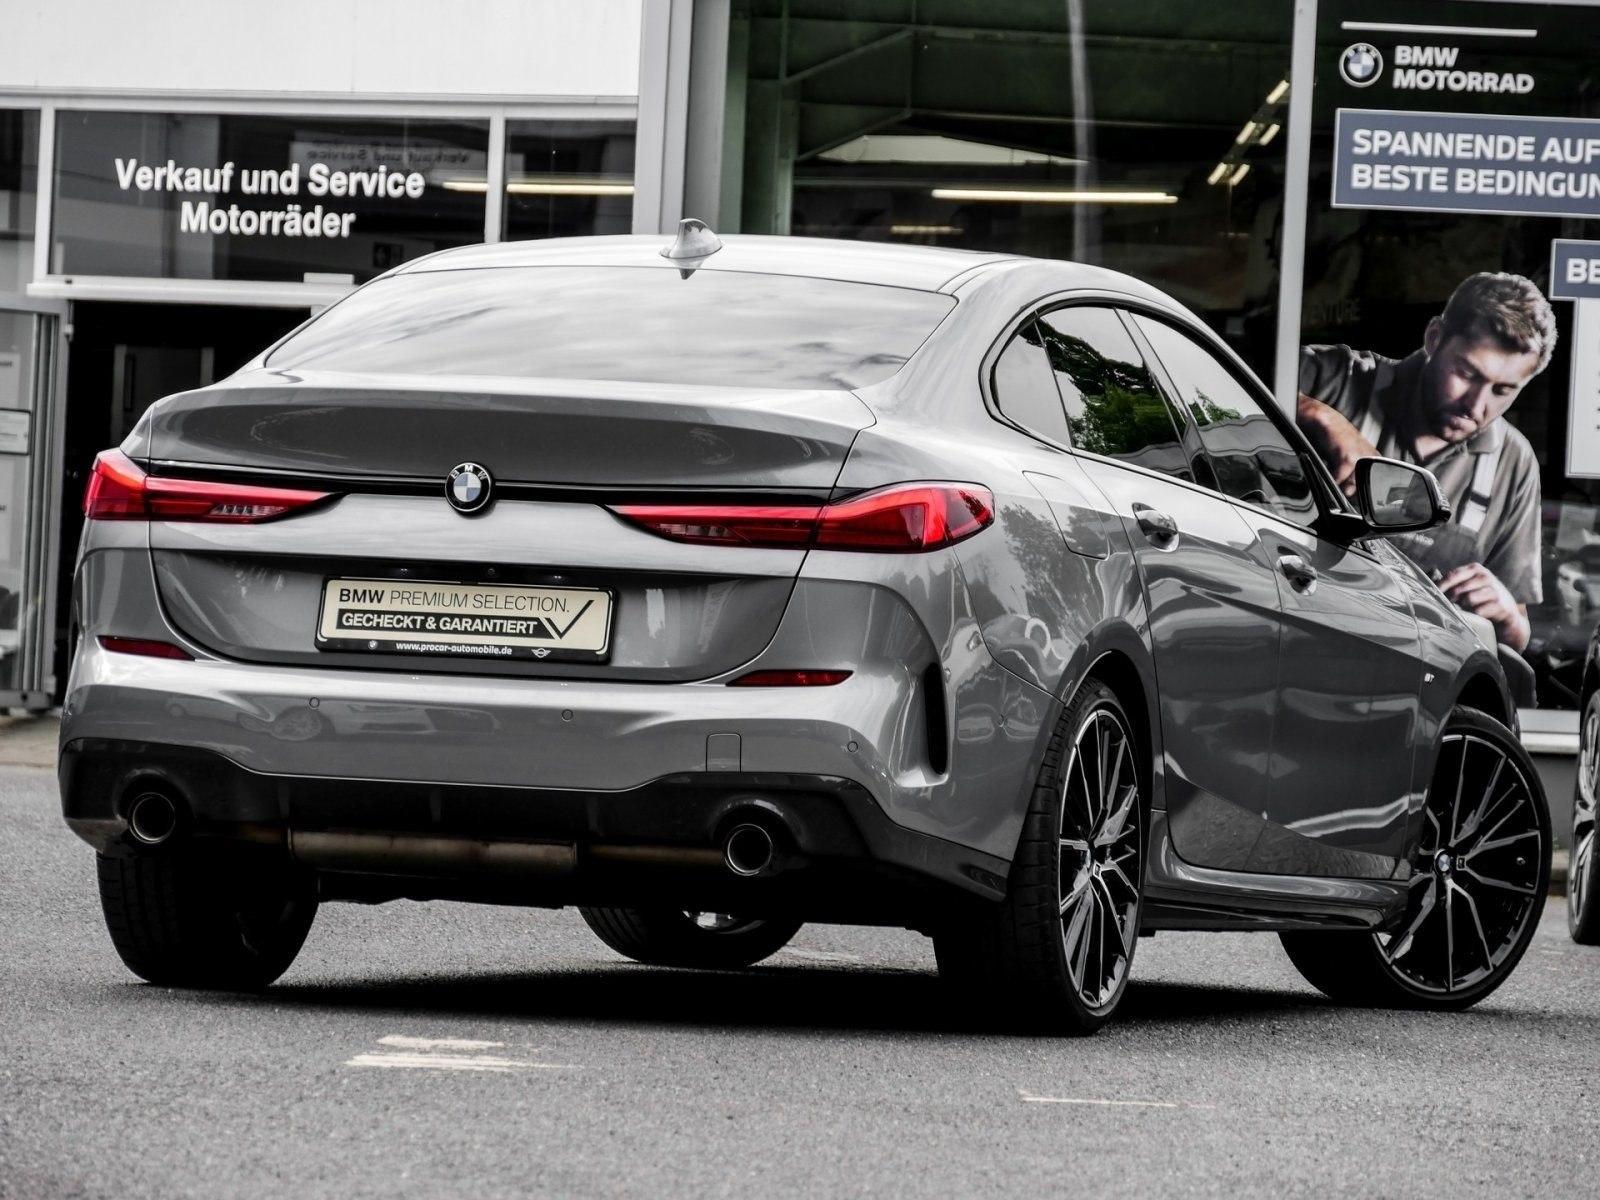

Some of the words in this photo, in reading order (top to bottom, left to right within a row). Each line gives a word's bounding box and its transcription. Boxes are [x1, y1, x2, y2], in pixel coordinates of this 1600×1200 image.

[1394, 45, 1460, 67] BMW
[1392, 68, 1536, 94] MOTORRAD
[1352, 128, 1537, 162] SPANNENDE
[114, 158, 235, 194] Verkauf
[241, 163, 300, 196] und
[308, 163, 426, 199] Service
[1351, 163, 1450, 192] BESTE
[180, 201, 356, 238] Motorräder
[450, 464, 488, 480] BMW
[339, 588, 385, 604] BMW
[390, 590, 468, 608] PREMIUM
[342, 612, 424, 631] GECHECKT
[425, 617, 437, 630] &
[439, 617, 538, 635] GARANTIERT
[395, 641, 513, 656] www.procar-automobile.de
